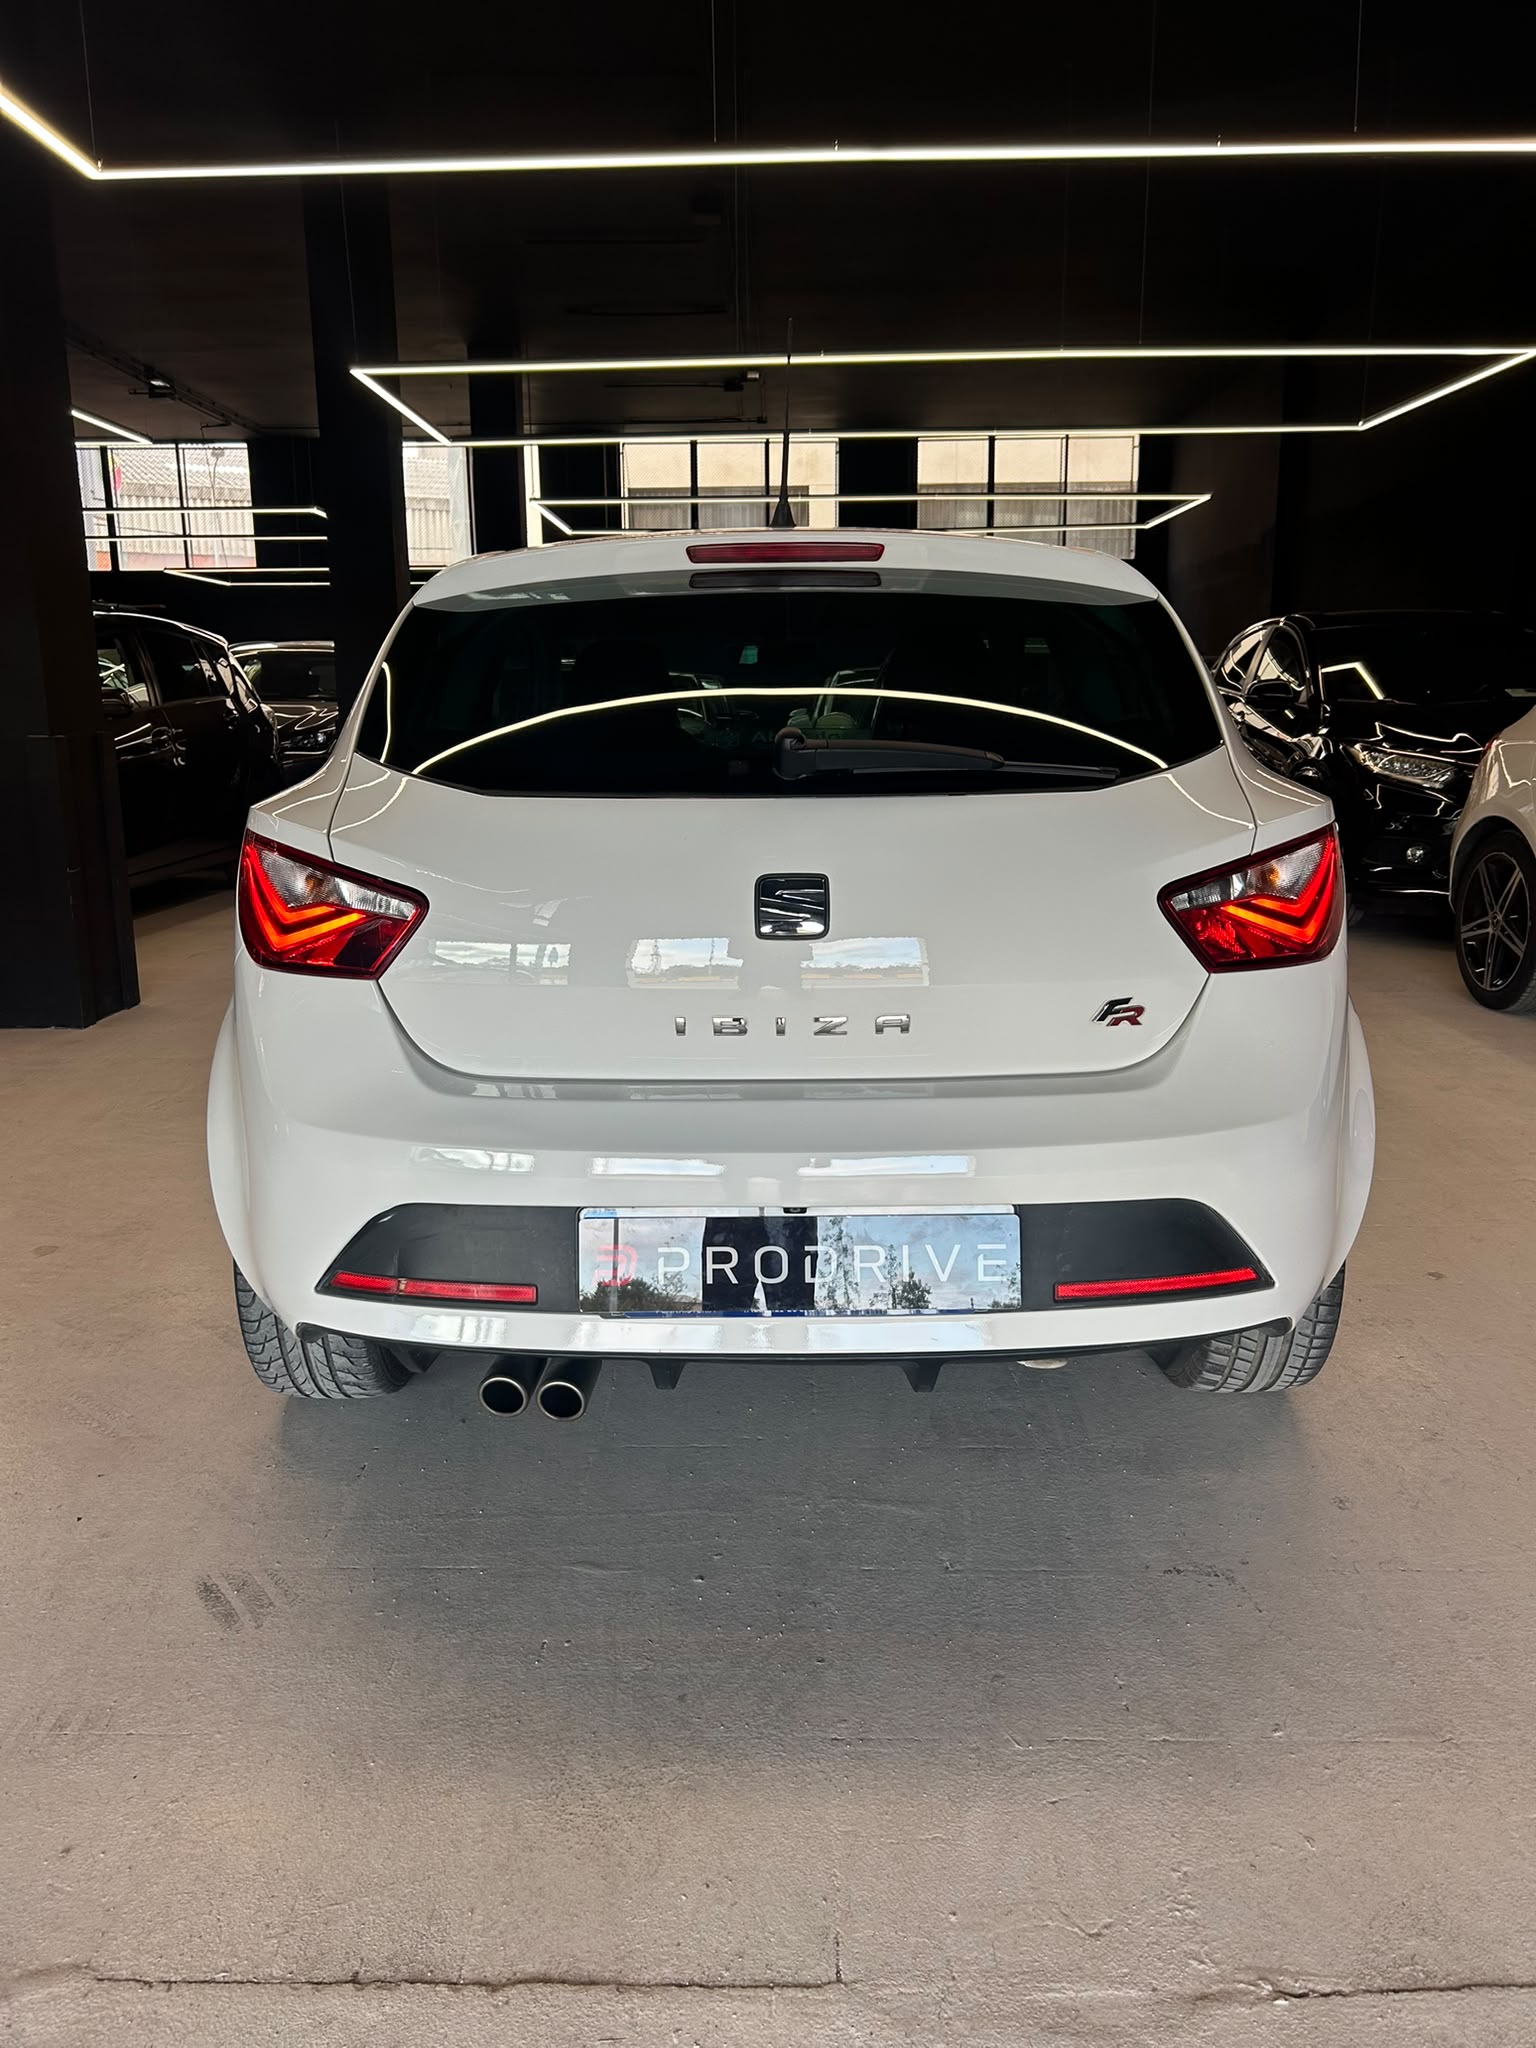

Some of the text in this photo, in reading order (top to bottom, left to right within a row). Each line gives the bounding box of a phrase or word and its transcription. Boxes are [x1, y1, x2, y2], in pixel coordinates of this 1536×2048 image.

[675, 1014, 910, 1036] IBIZA
[1090, 996, 1145, 1027] FR
[657, 1244, 1007, 1285] PRODRIVE
